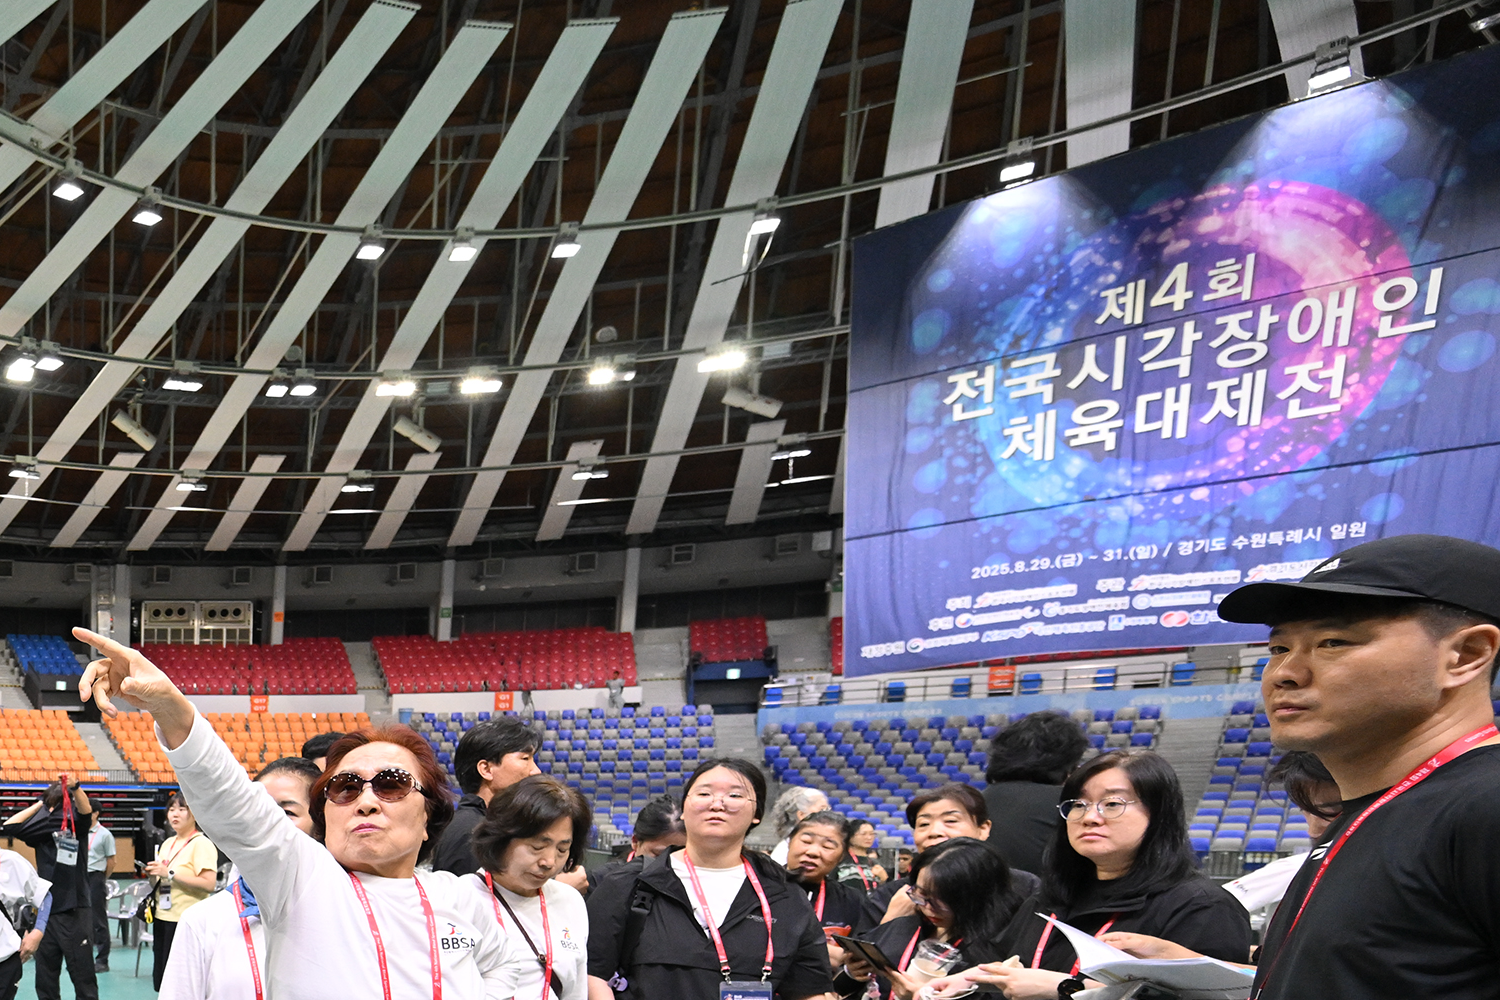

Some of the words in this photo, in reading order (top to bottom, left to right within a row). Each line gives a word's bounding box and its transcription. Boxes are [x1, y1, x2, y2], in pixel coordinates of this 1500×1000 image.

[1095, 253, 1256, 326] 제4회
[942, 266, 1444, 422] 전국시각장애인
[1000, 355, 1346, 462] 체육대제전
[971, 553, 1083, 579] 2025.8.29.(금)
[1103, 545, 1157, 561] 31.(일)
[1178, 537, 1226, 555] 경기도
[1232, 526, 1321, 550] 수원특례시
[1330, 522, 1366, 539] 일원
